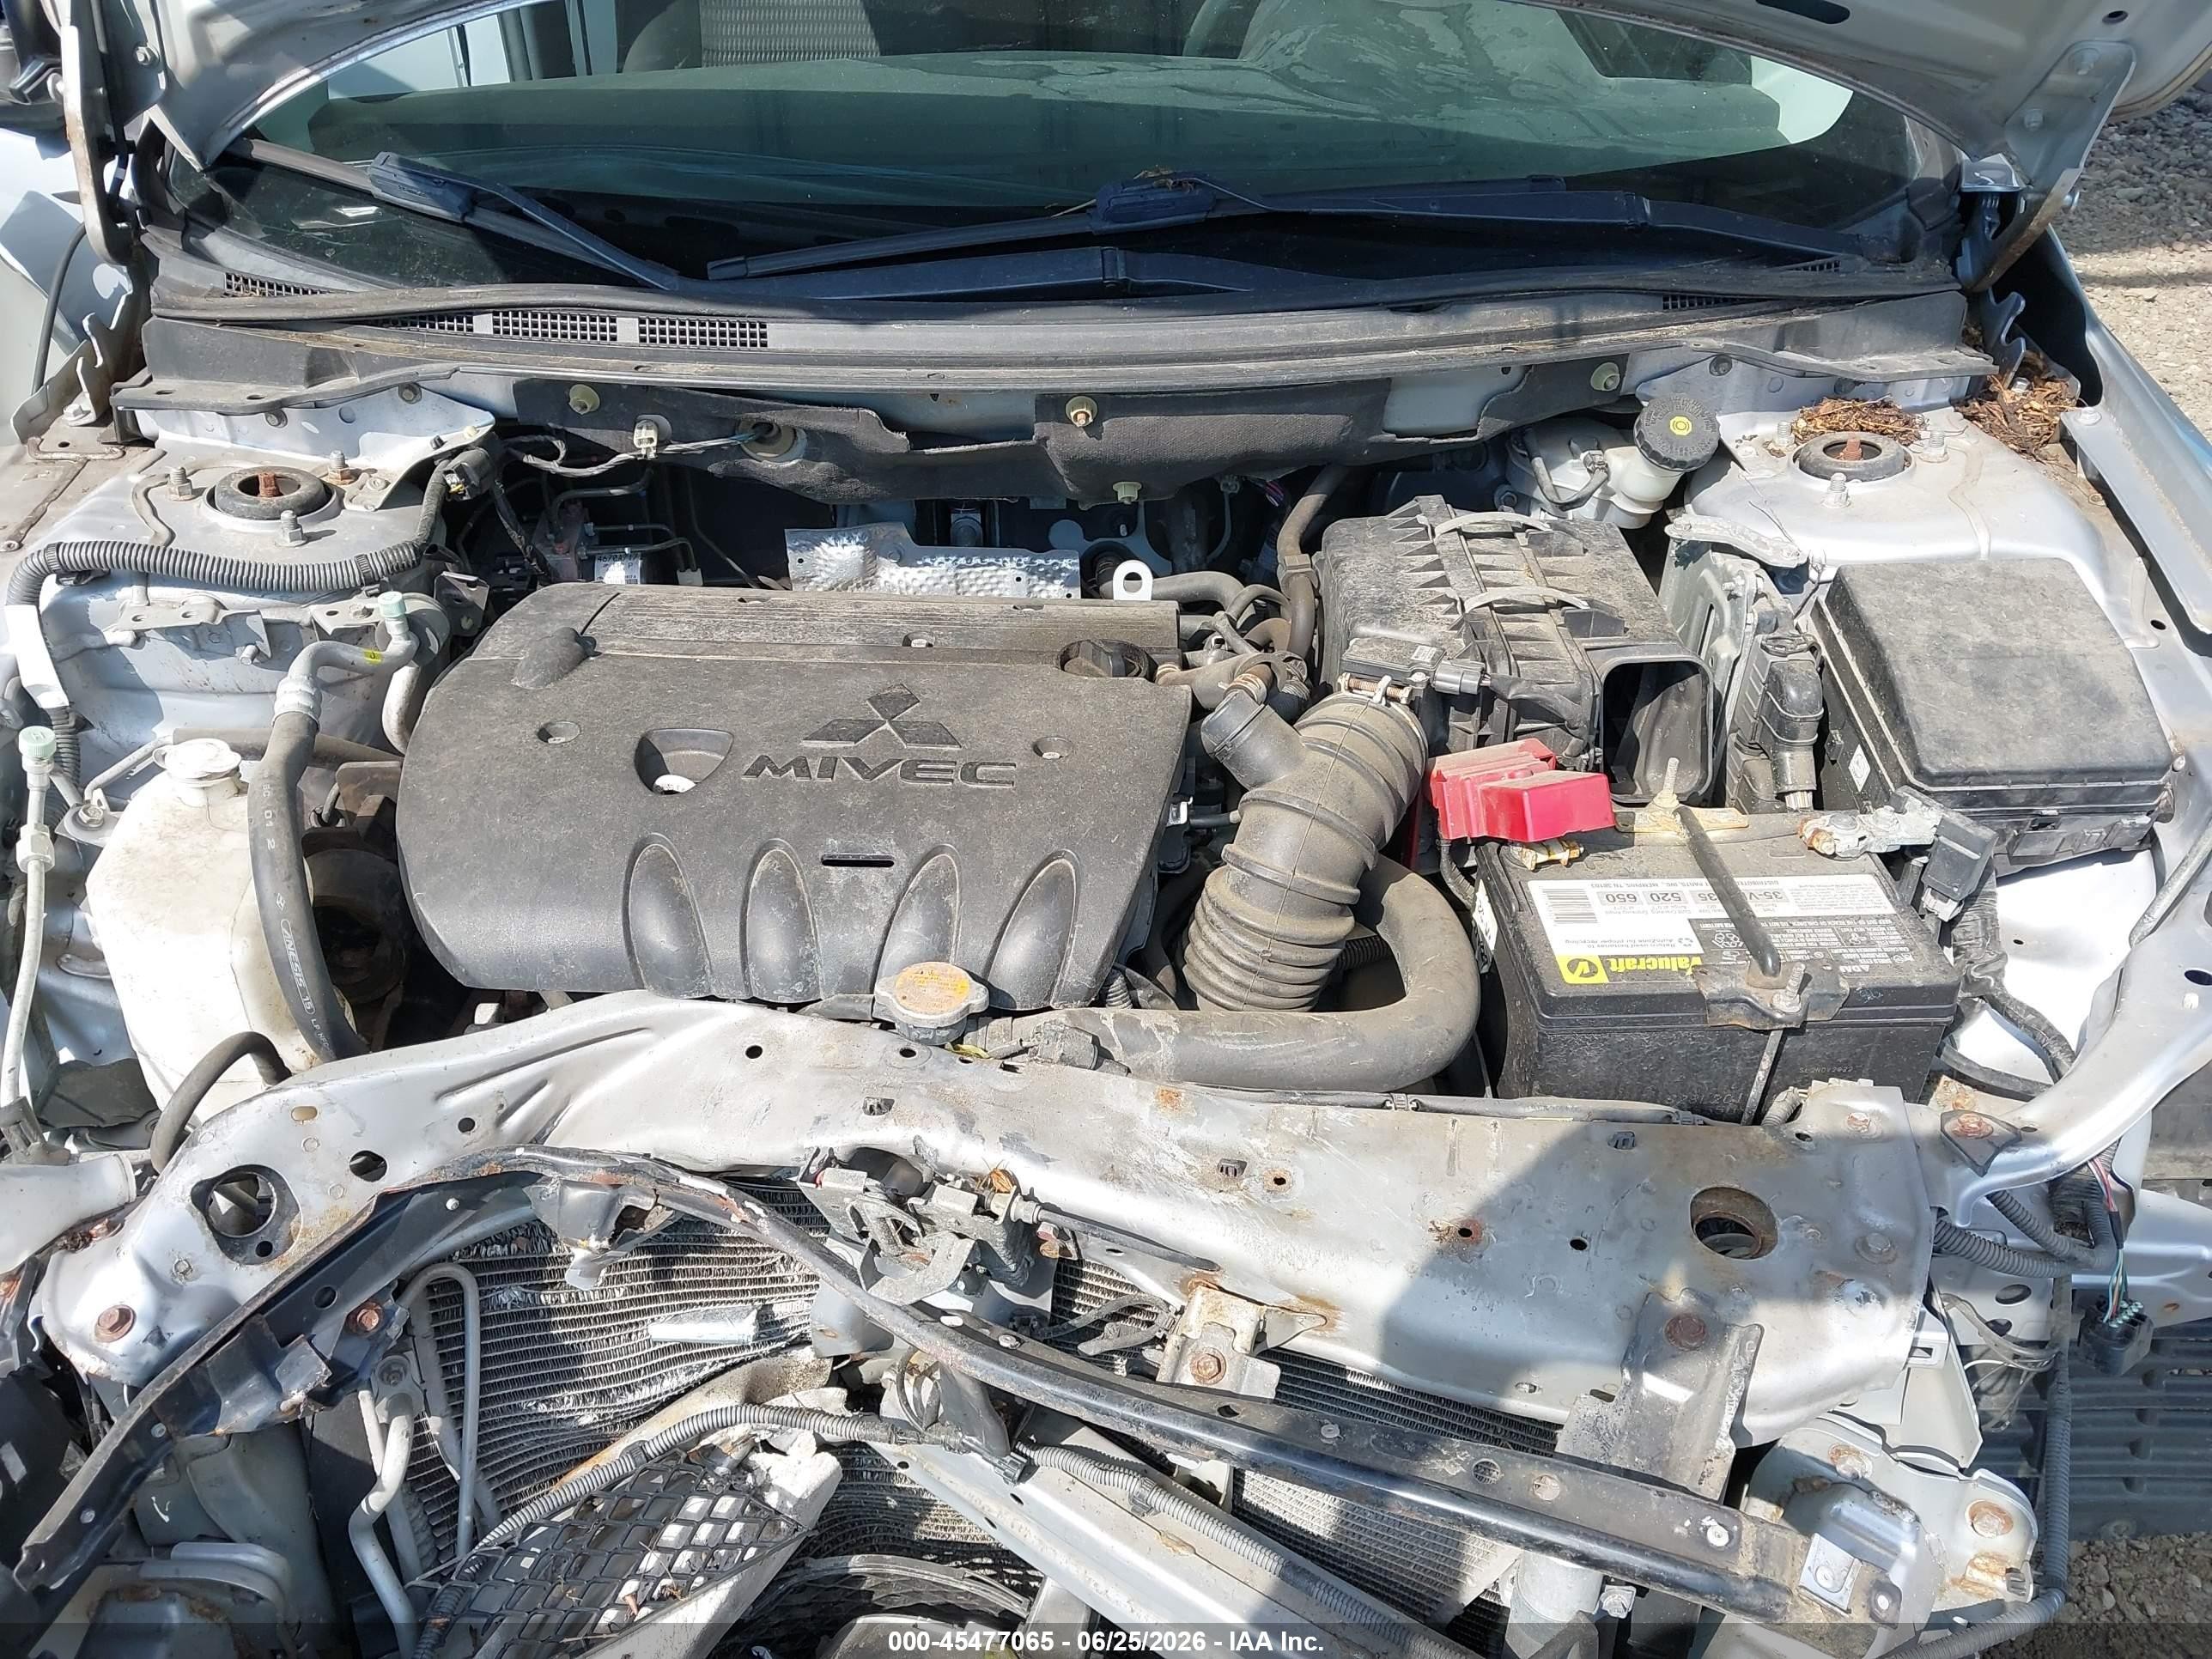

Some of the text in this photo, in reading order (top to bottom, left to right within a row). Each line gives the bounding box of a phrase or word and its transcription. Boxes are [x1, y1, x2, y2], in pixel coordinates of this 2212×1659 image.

[742, 755, 1017, 787] MIVEC
[1606, 893, 1637, 903] 650
[1650, 892, 1681, 902] 520
[1698, 892, 1717, 902] 35
[282, 927, 313, 1010] ANESIS 15
[1606, 956, 1703, 976] Valucraft
